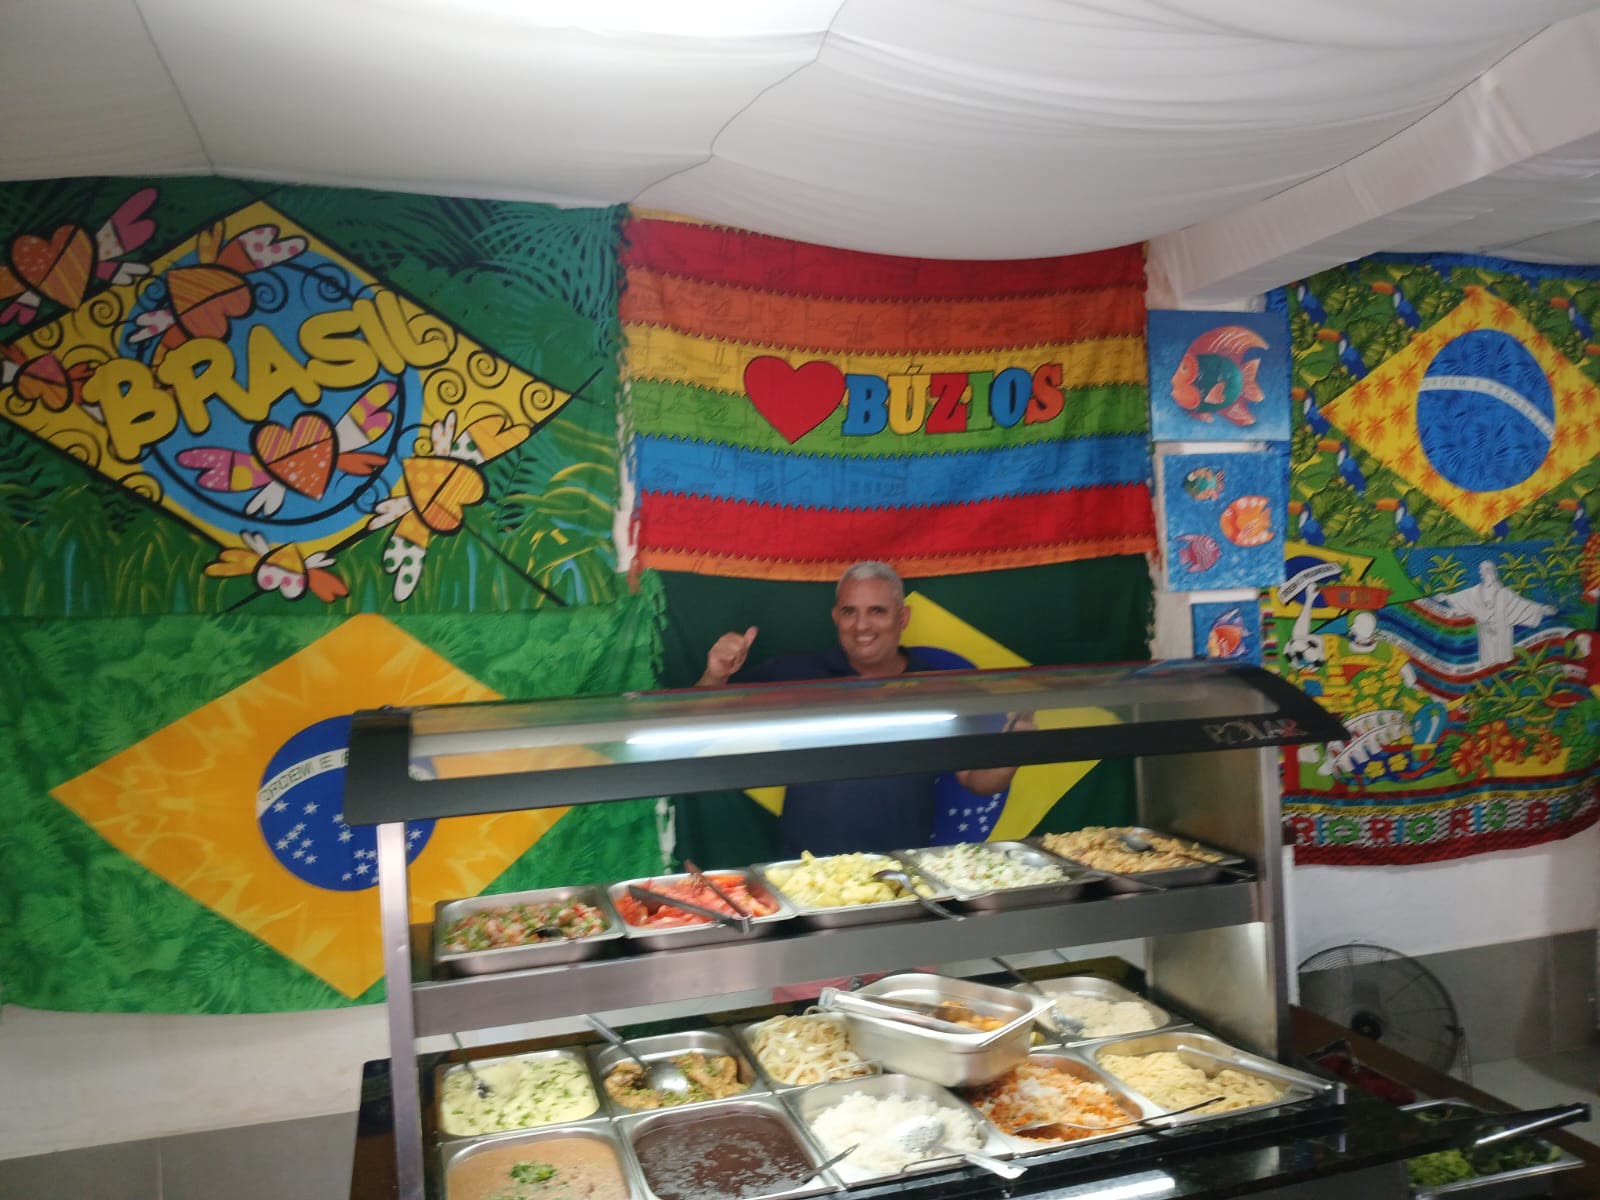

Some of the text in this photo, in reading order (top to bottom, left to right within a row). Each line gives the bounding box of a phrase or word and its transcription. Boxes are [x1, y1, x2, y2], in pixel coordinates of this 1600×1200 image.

[82, 288, 453, 460] BRASIL
[841, 364, 1065, 437] BÚZIOS
[1291, 815, 1360, 845] RIO
[1370, 815, 1436, 844] RIO
